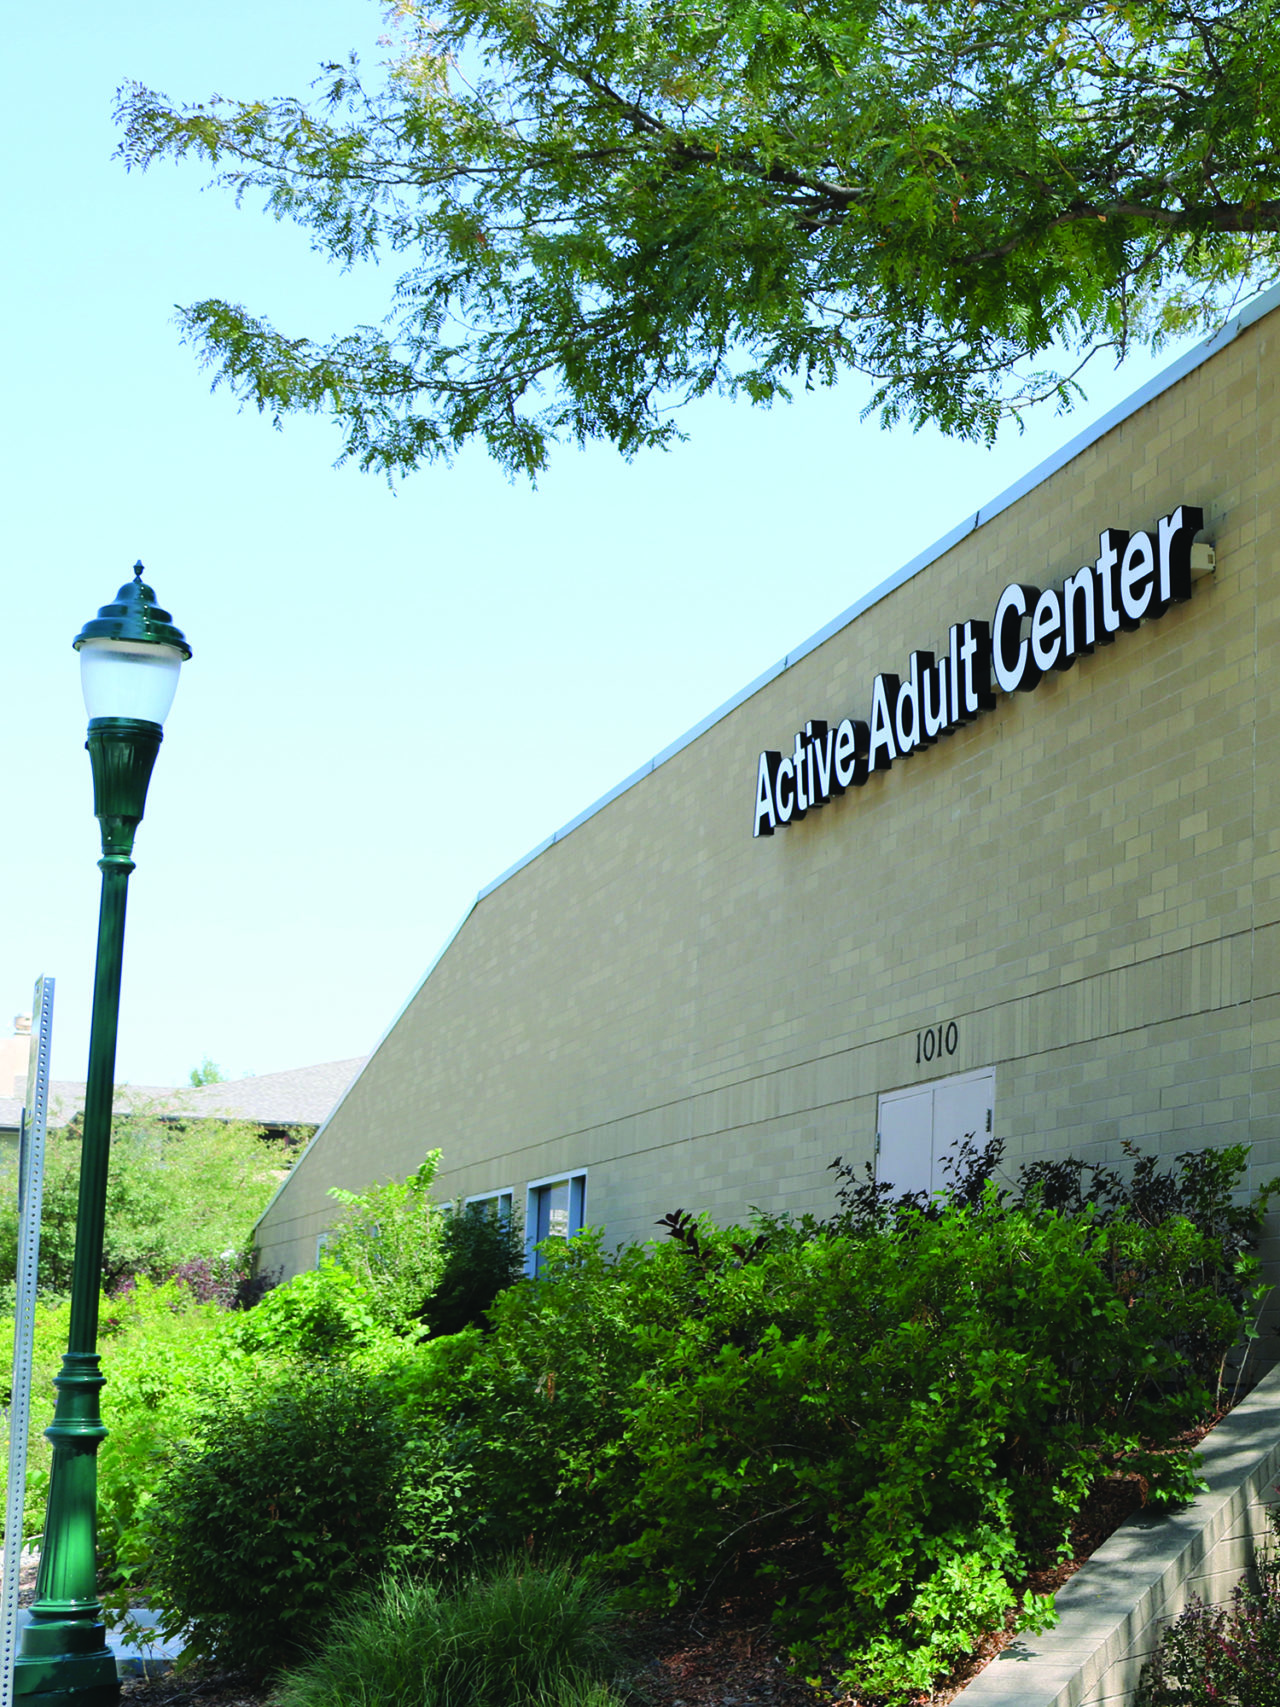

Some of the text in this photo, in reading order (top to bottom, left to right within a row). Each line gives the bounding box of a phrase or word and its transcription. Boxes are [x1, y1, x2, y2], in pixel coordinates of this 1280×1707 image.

[753, 505, 1187, 837] Active Adult Center
[916, 1021, 958, 1064] 1010
